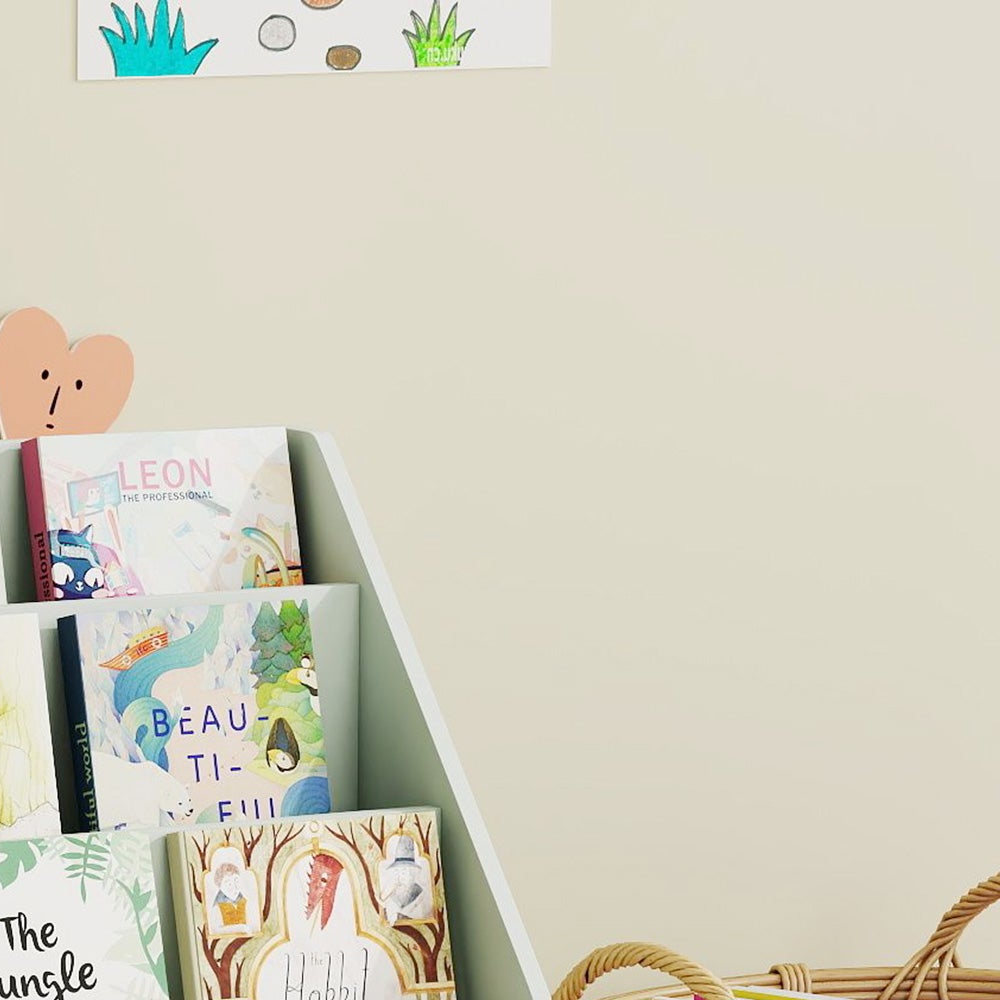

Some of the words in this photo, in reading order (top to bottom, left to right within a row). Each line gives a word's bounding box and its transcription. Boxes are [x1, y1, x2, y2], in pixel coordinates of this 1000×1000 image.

[118, 457, 213, 491] LEON
[122, 493, 140, 503] THE
[142, 490, 214, 502] PROFESSIONAL
[153, 703, 269, 737] BEAU-
[75, 721, 92, 785] world
[187, 753, 242, 782] TI-
[310, 952, 324, 966] the
